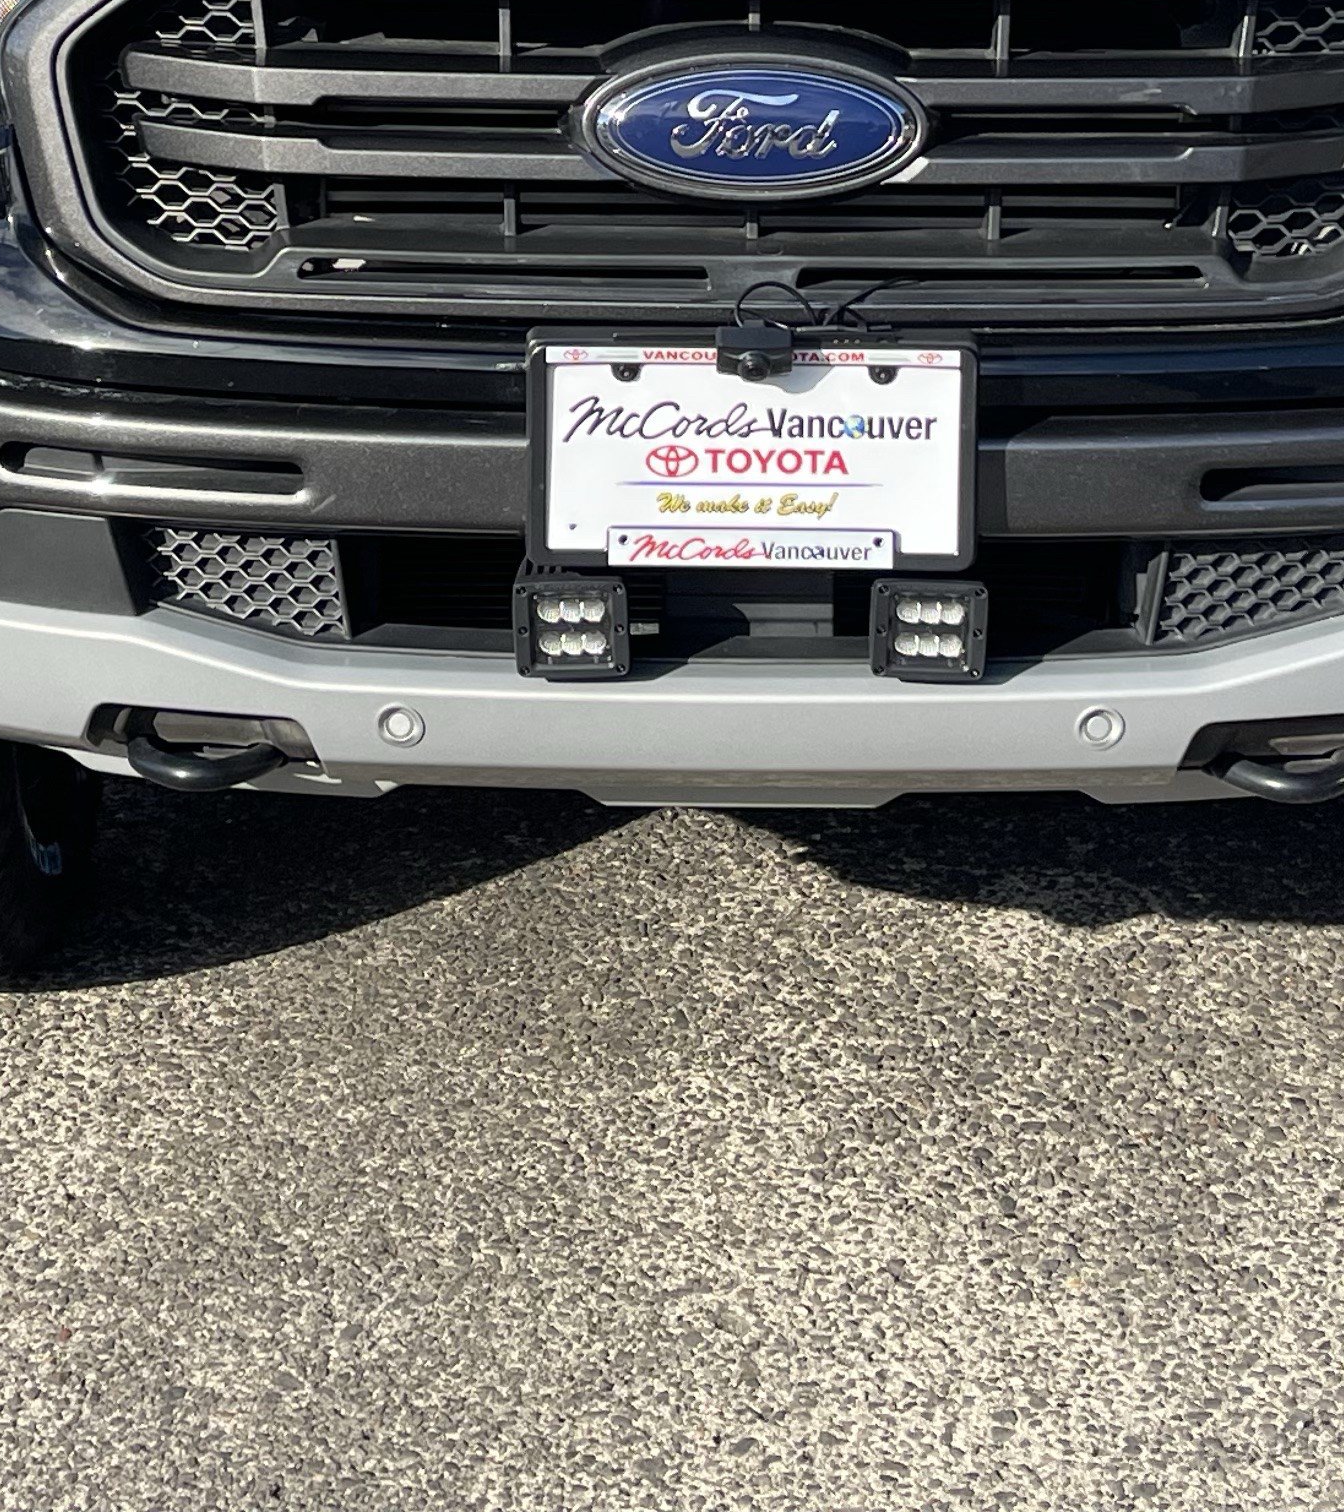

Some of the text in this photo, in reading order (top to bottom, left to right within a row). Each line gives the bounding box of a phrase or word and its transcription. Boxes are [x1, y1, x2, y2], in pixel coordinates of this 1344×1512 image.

[669, 89, 841, 163] Ford
[704, 448, 850, 476] TOYOTA
[656, 491, 840, 521] We make it Easy!
